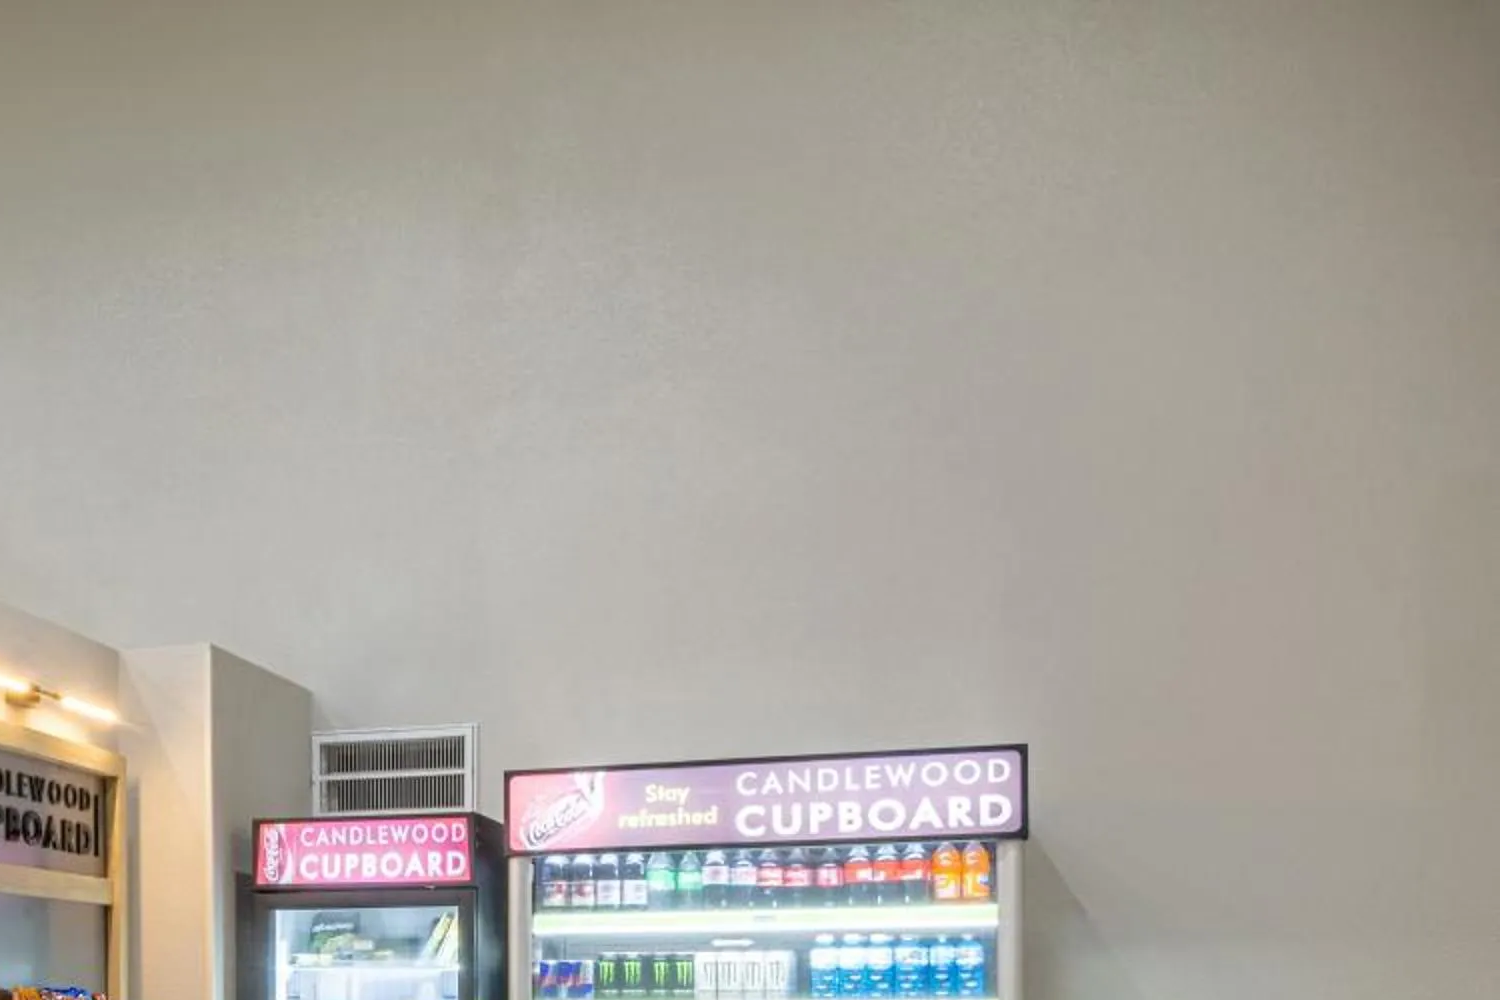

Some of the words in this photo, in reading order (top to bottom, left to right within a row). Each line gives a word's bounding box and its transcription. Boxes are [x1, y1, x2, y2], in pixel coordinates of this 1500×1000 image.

[736, 758, 1011, 796] CANDLEWOOD
[645, 784, 691, 805] Stay
[618, 805, 719, 829] refreshed
[734, 794, 1013, 837] CUPBOARD
[300, 822, 466, 847] CANDLEWOOD
[299, 850, 467, 880] CUPBOARD
